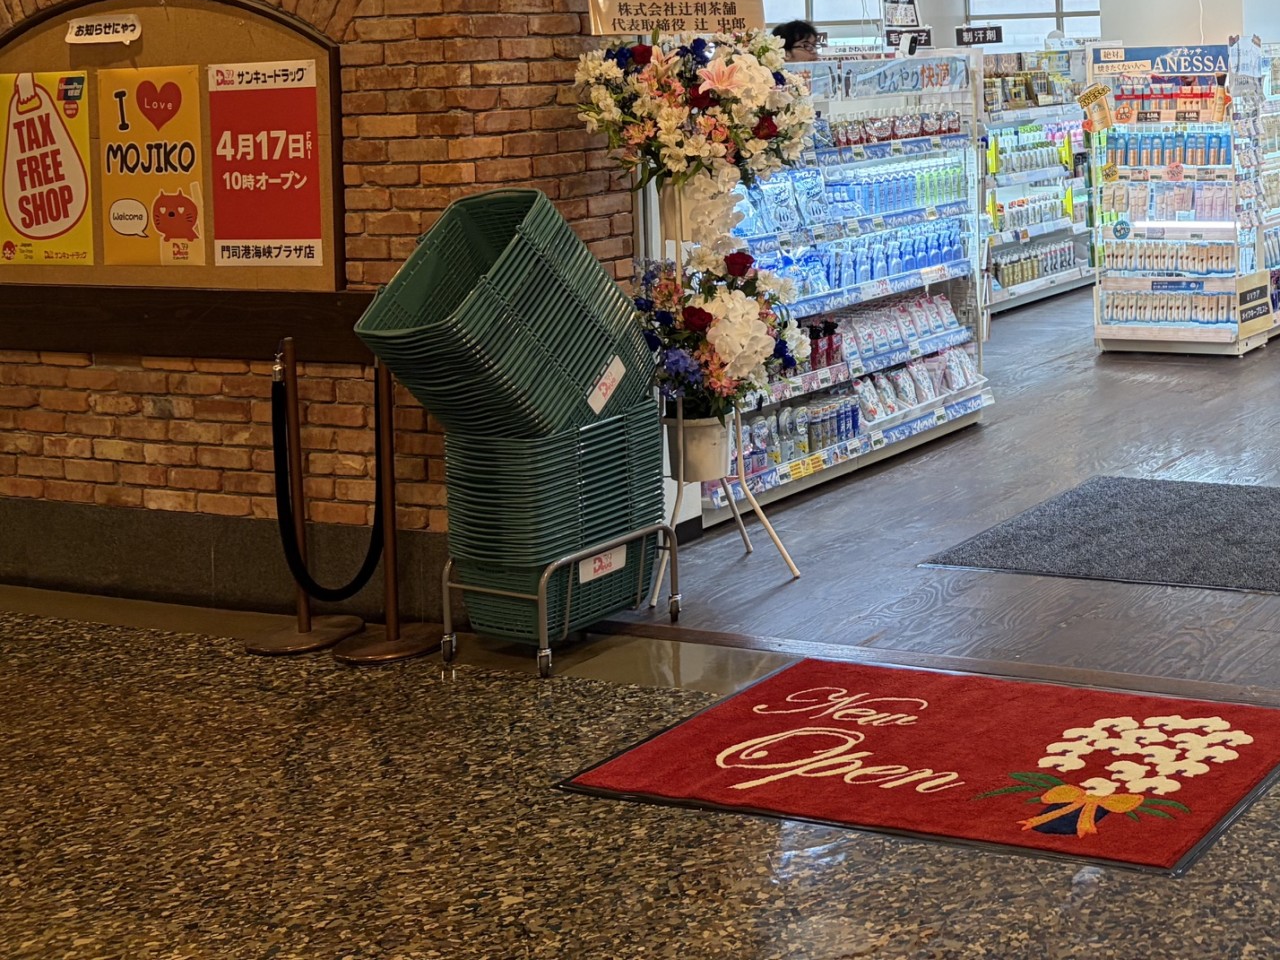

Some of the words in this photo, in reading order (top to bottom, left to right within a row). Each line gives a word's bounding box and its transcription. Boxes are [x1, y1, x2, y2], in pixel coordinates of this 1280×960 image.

[618, 2, 737, 17] 株式会社辻利茶舗
[611, 18, 687, 32] 代表取締役
[963, 29, 996, 42] 制汗剤
[237, 67, 307, 85] サンキュードラッグ
[877, 63, 949, 90] ひんやり快適
[1152, 55, 1227, 73] ANESSA
[1081, 85, 1111, 108] ANESSA
[114, 90, 130, 131] I
[144, 97, 173, 110] Love
[13, 112, 56, 153] TAX
[106, 141, 195, 174] MOJIKO
[216, 130, 304, 161] 4月17日
[16, 149, 65, 191] FREE
[223, 170, 307, 190] 10時オープン
[18, 184, 73, 228] SHOP
[112, 211, 144, 223] Welcome
[220, 245, 315, 260] 門司港海峡プラザ店
[754, 687, 929, 729] New
[715, 726, 965, 794] Open
